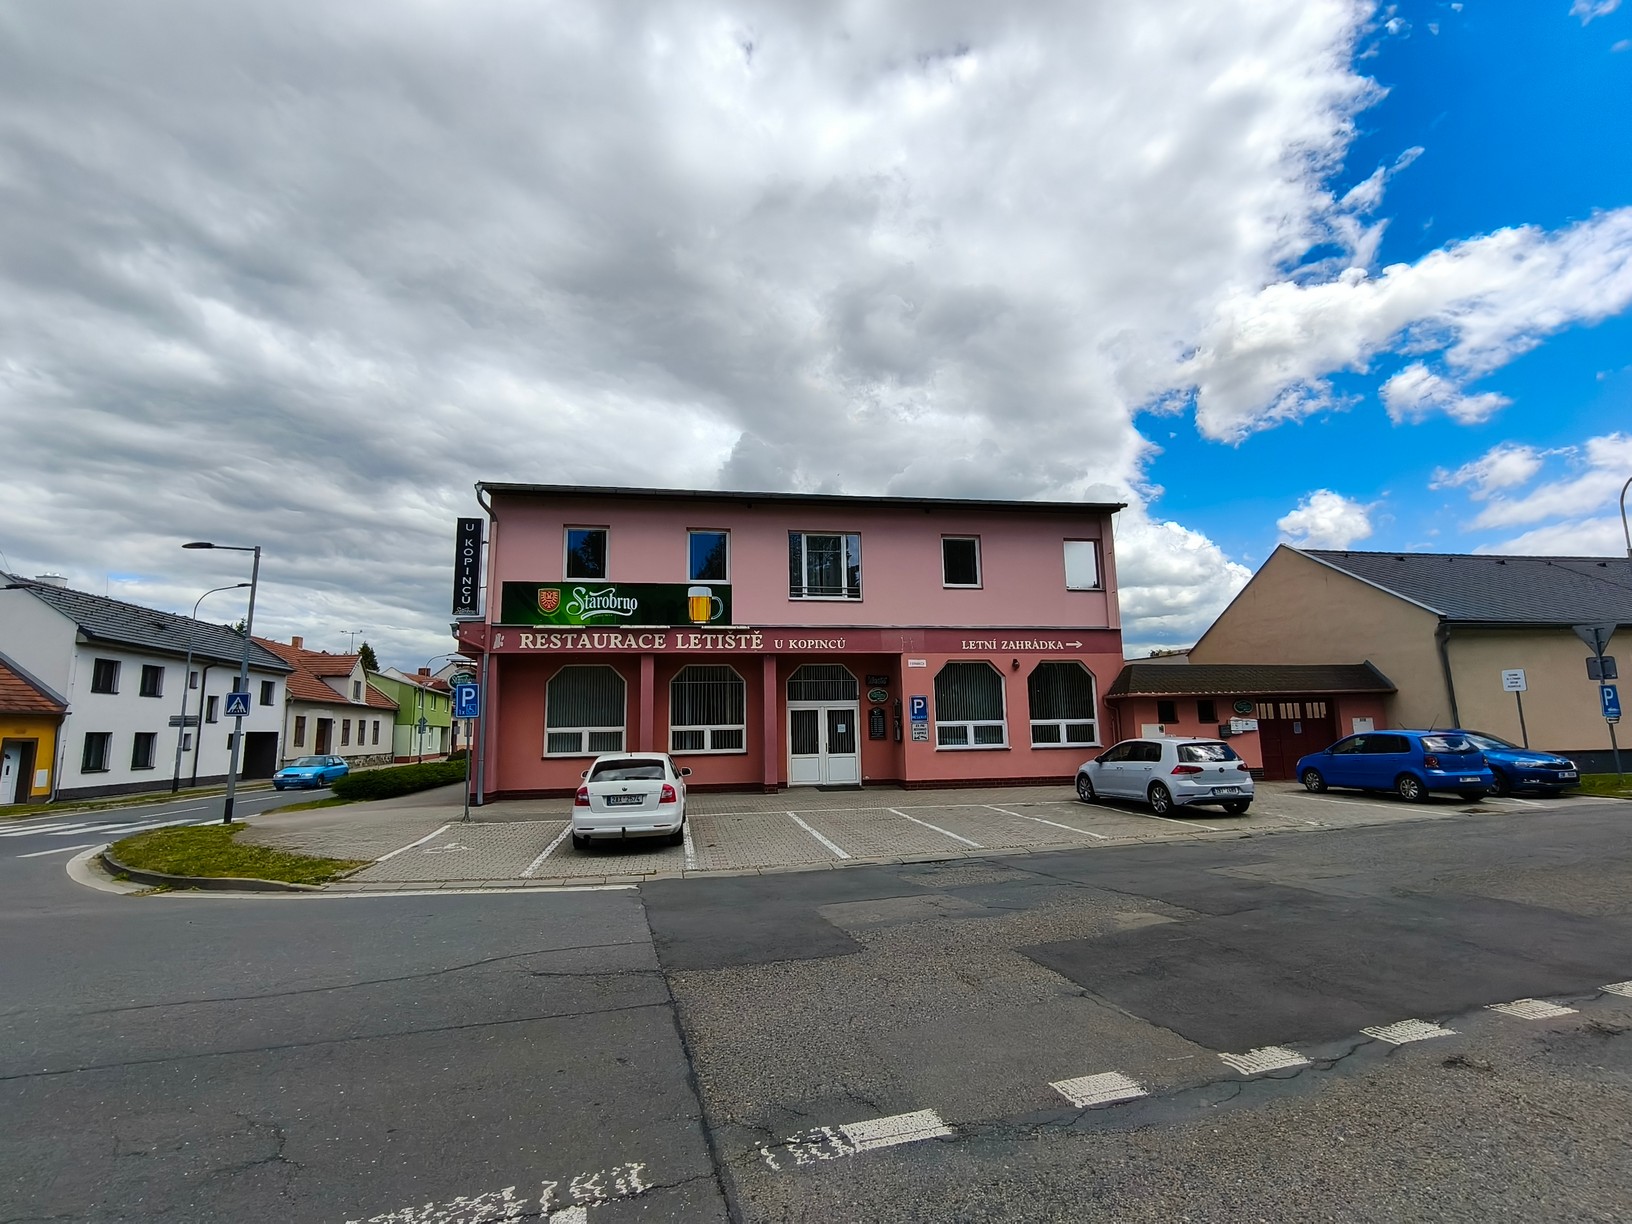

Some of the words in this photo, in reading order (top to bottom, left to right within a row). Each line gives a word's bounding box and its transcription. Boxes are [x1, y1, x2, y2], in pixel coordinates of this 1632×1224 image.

[465, 523, 475, 532] U
[461, 538, 474, 604] KOPINCŮ
[566, 586, 638, 621] Starobrno
[519, 633, 666, 649] RESTAURACE
[676, 630, 764, 649] LETIŠTĚ
[774, 639, 783, 649] U
[788, 637, 846, 649] KOPINCŮ
[961, 638, 997, 650] LETNÍ
[1001, 638, 1064, 650] ZAHRÁDKA
[462, 687, 476, 707] P
[1603, 687, 1614, 706] P
[913, 699, 925, 714] P
